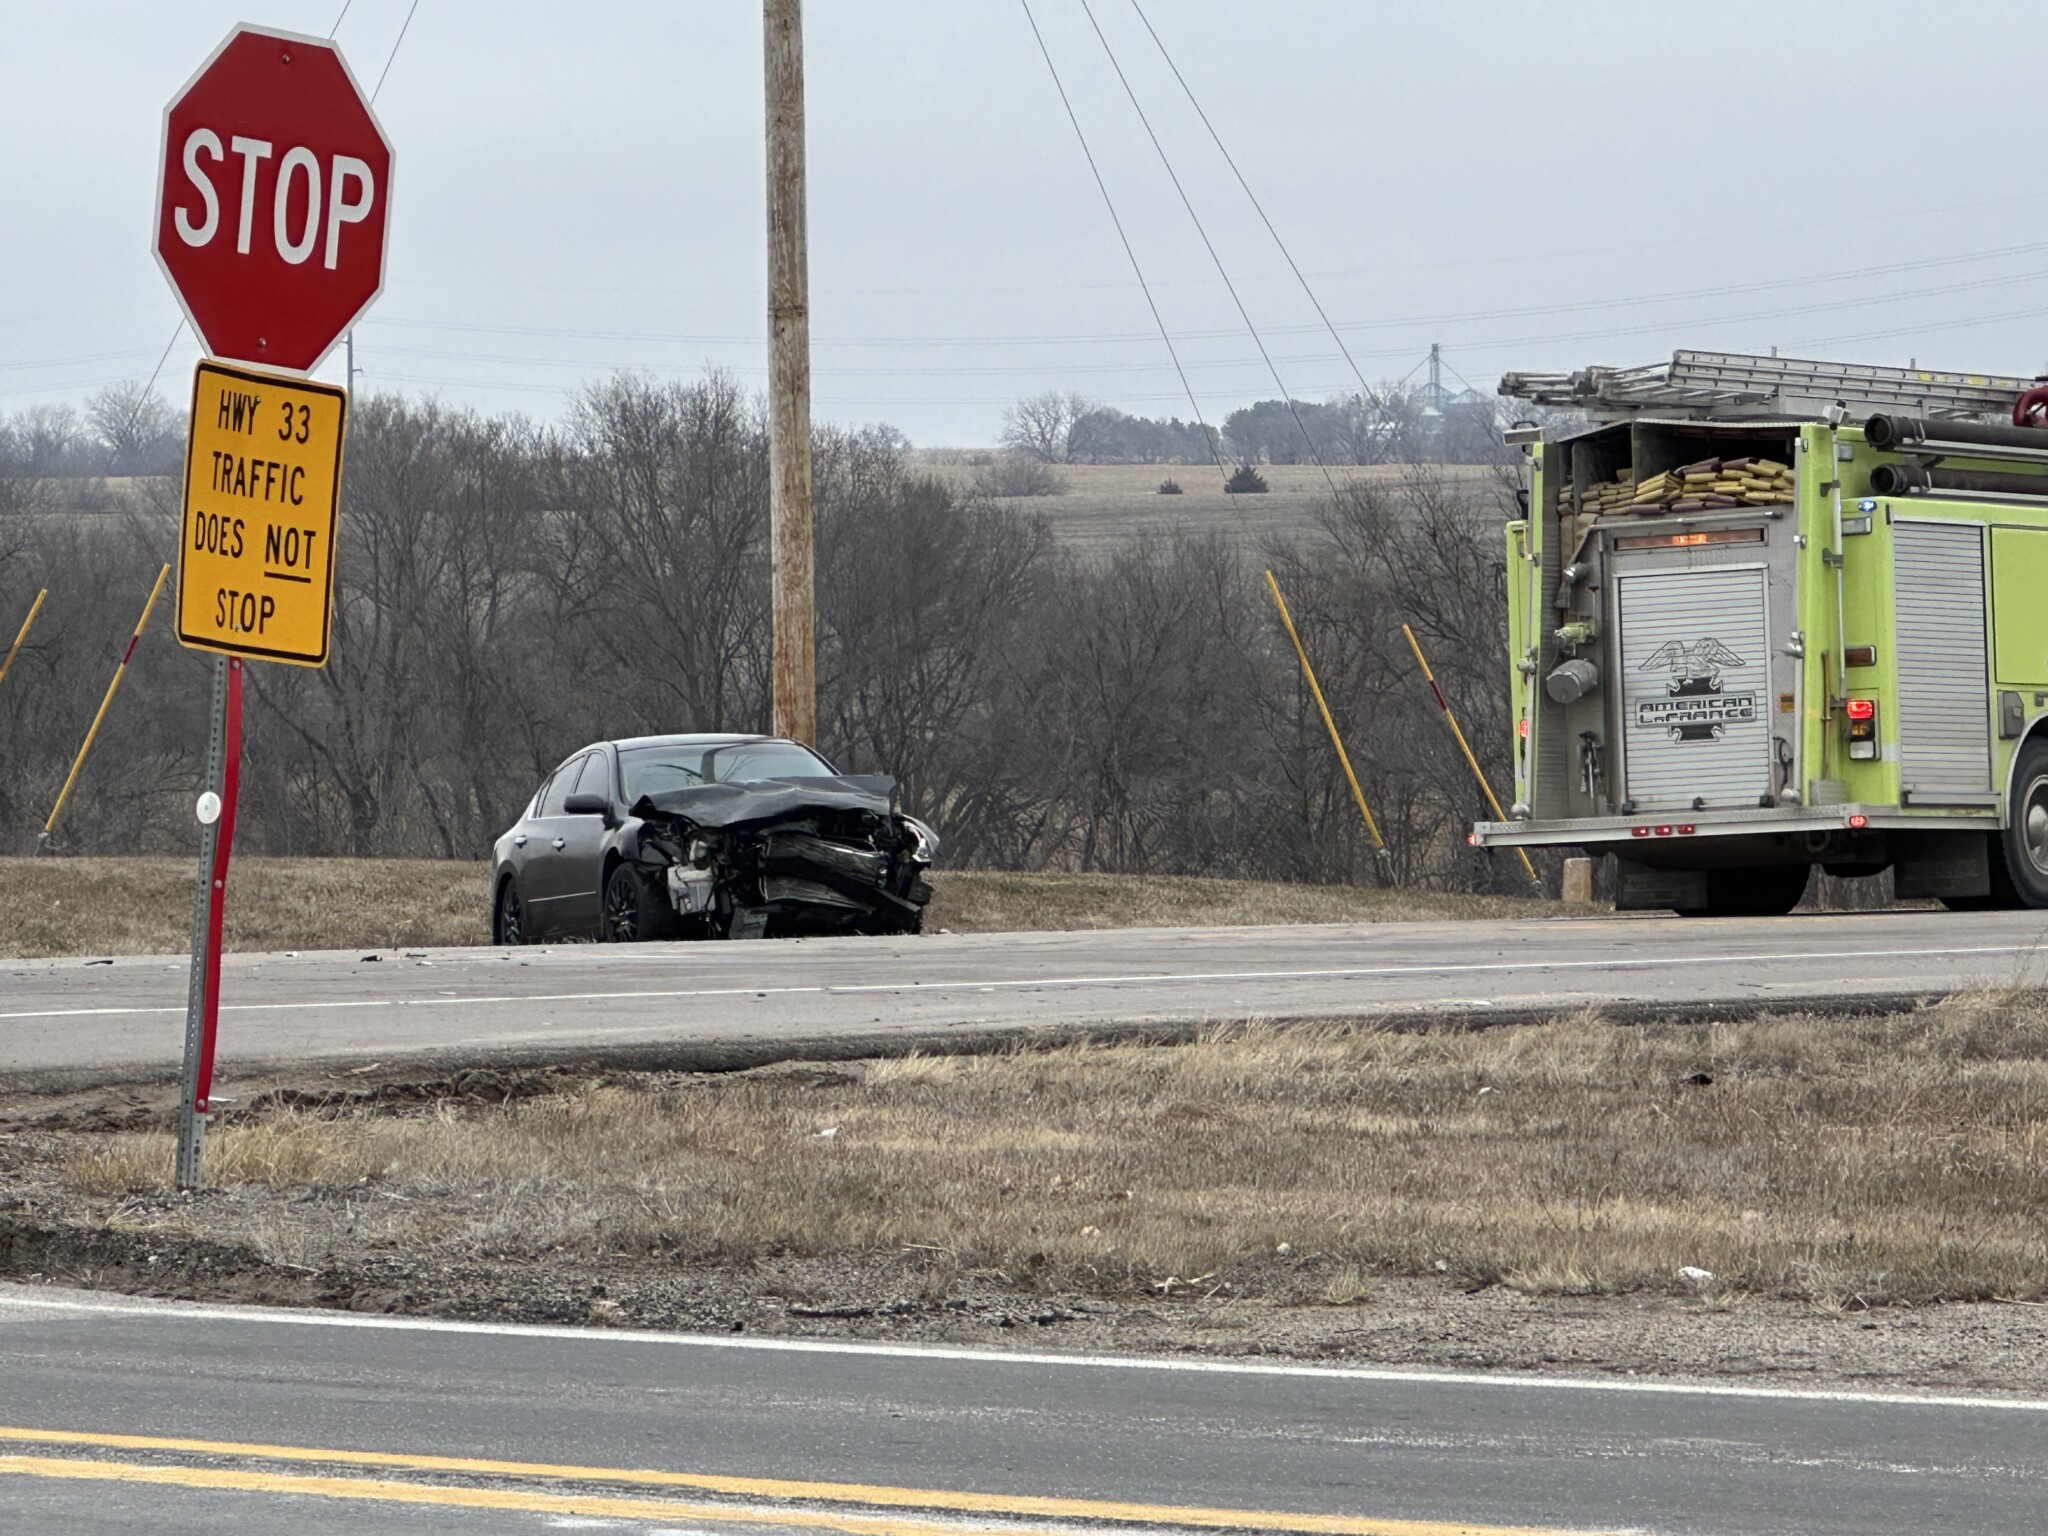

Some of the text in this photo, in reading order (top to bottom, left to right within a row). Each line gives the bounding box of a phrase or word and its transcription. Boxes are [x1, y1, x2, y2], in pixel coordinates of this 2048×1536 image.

[174, 127, 375, 271] STOP
[217, 388, 311, 445] HWY 33
[212, 451, 306, 506] TRAFFIC
[194, 510, 317, 570] DOES NOT
[215, 587, 275, 635] STOP
